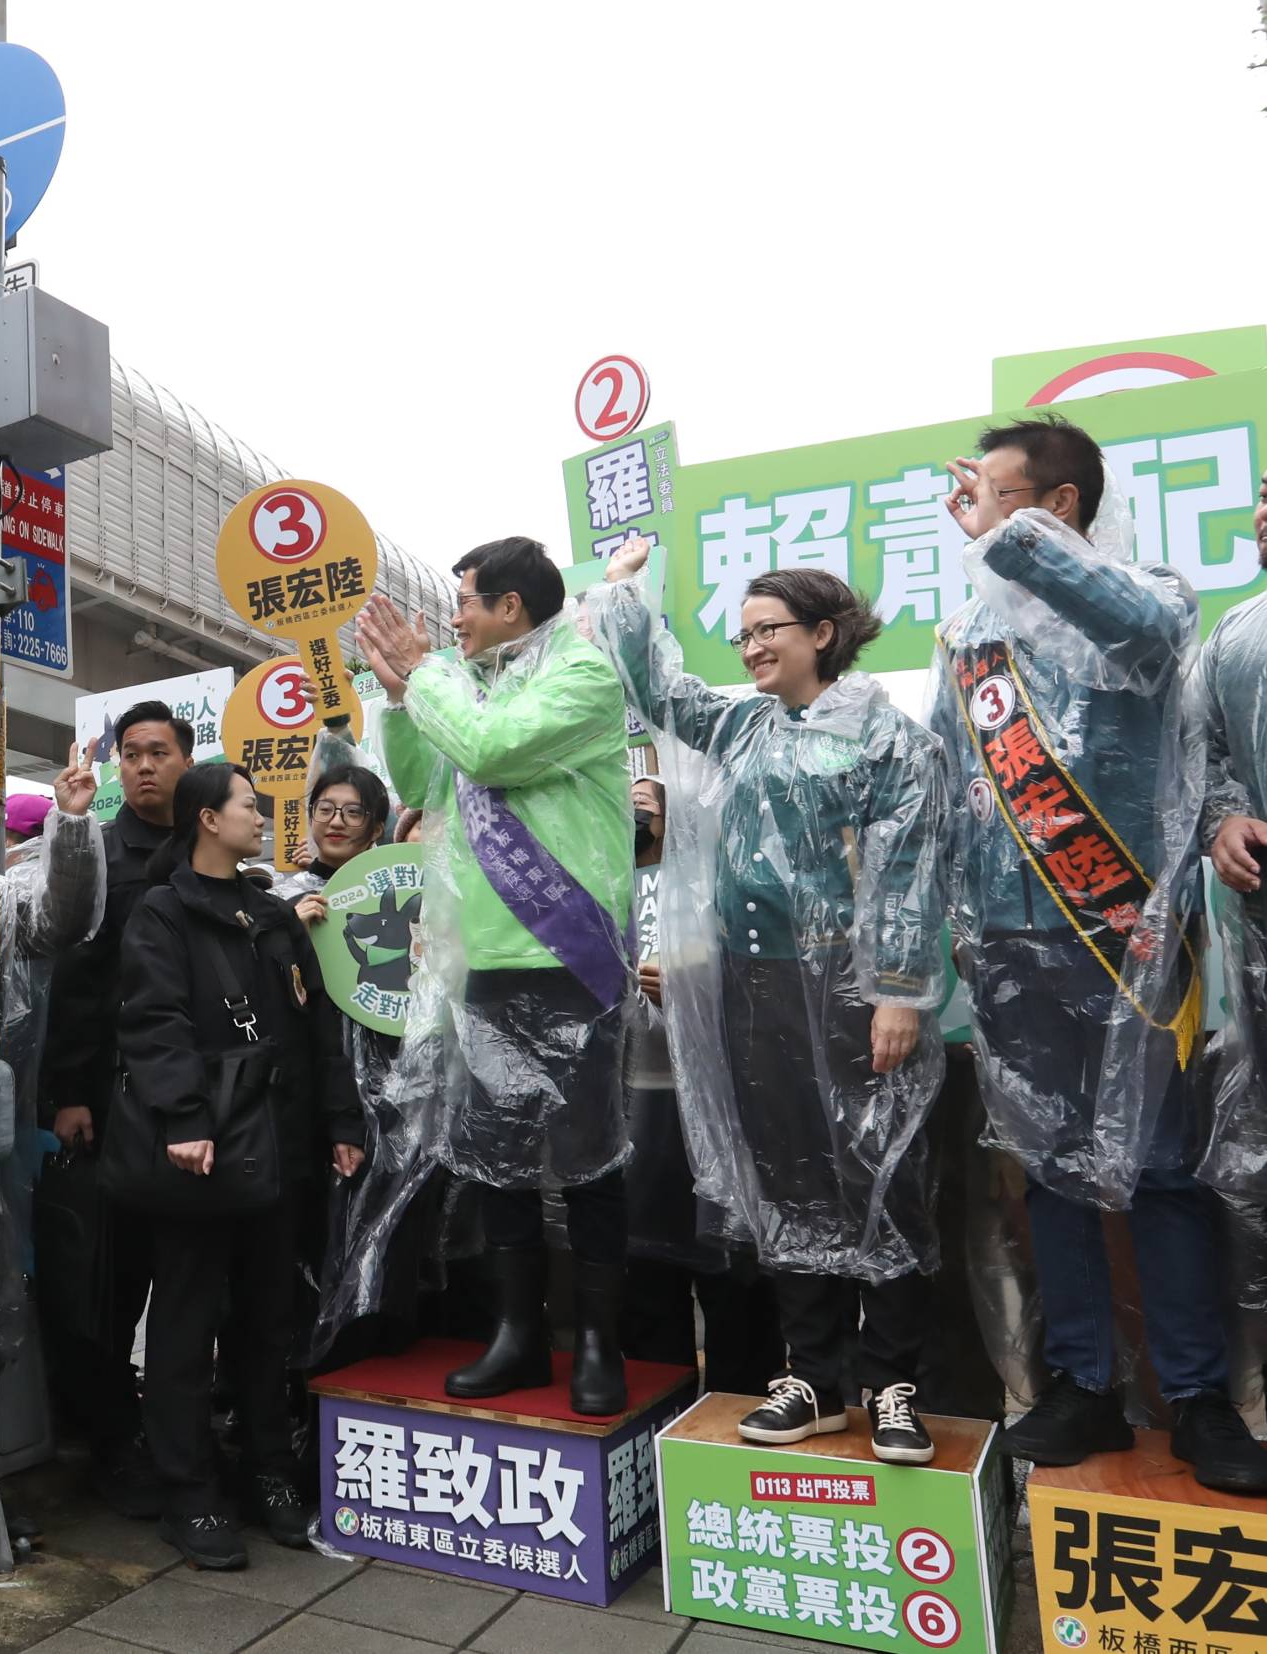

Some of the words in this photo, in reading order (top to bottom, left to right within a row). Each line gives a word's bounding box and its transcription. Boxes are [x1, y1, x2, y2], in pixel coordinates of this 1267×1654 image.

[592, 366, 628, 430] 2
[654, 446, 674, 514] 立法委員
[18, 521, 30, 541] ON
[32, 525, 64, 553] SIDEWALK
[264, 497, 314, 555] 3
[246, 556, 366, 621] 張宏陸
[276, 602, 354, 627] 板橋西區立委候選人
[275, 673, 308, 718] 3
[309, 637, 341, 709] 選好立委
[980, 682, 1006, 723] 3
[168, 695, 217, 724] 的人
[241, 734, 318, 773] 張宏
[90, 794, 123, 813] 2024
[985, 716, 1133, 907] 張宏陸
[368, 864, 424, 897] 選對
[495, 828, 571, 901] 板橋東區
[332, 888, 365, 908] 2024
[334, 1416, 587, 1546] 羅致政
[755, 1476, 791, 1496] 0113
[796, 1478, 871, 1501] 出門投票
[360, 1512, 588, 1584] 板橋東區立委候選人
[686, 1499, 894, 1577] 總統票投
[911, 1537, 940, 1574] 2
[690, 1558, 900, 1640] 政黨票投
[917, 1602, 946, 1637] 6
[1053, 1506, 1267, 1636] 張宏
